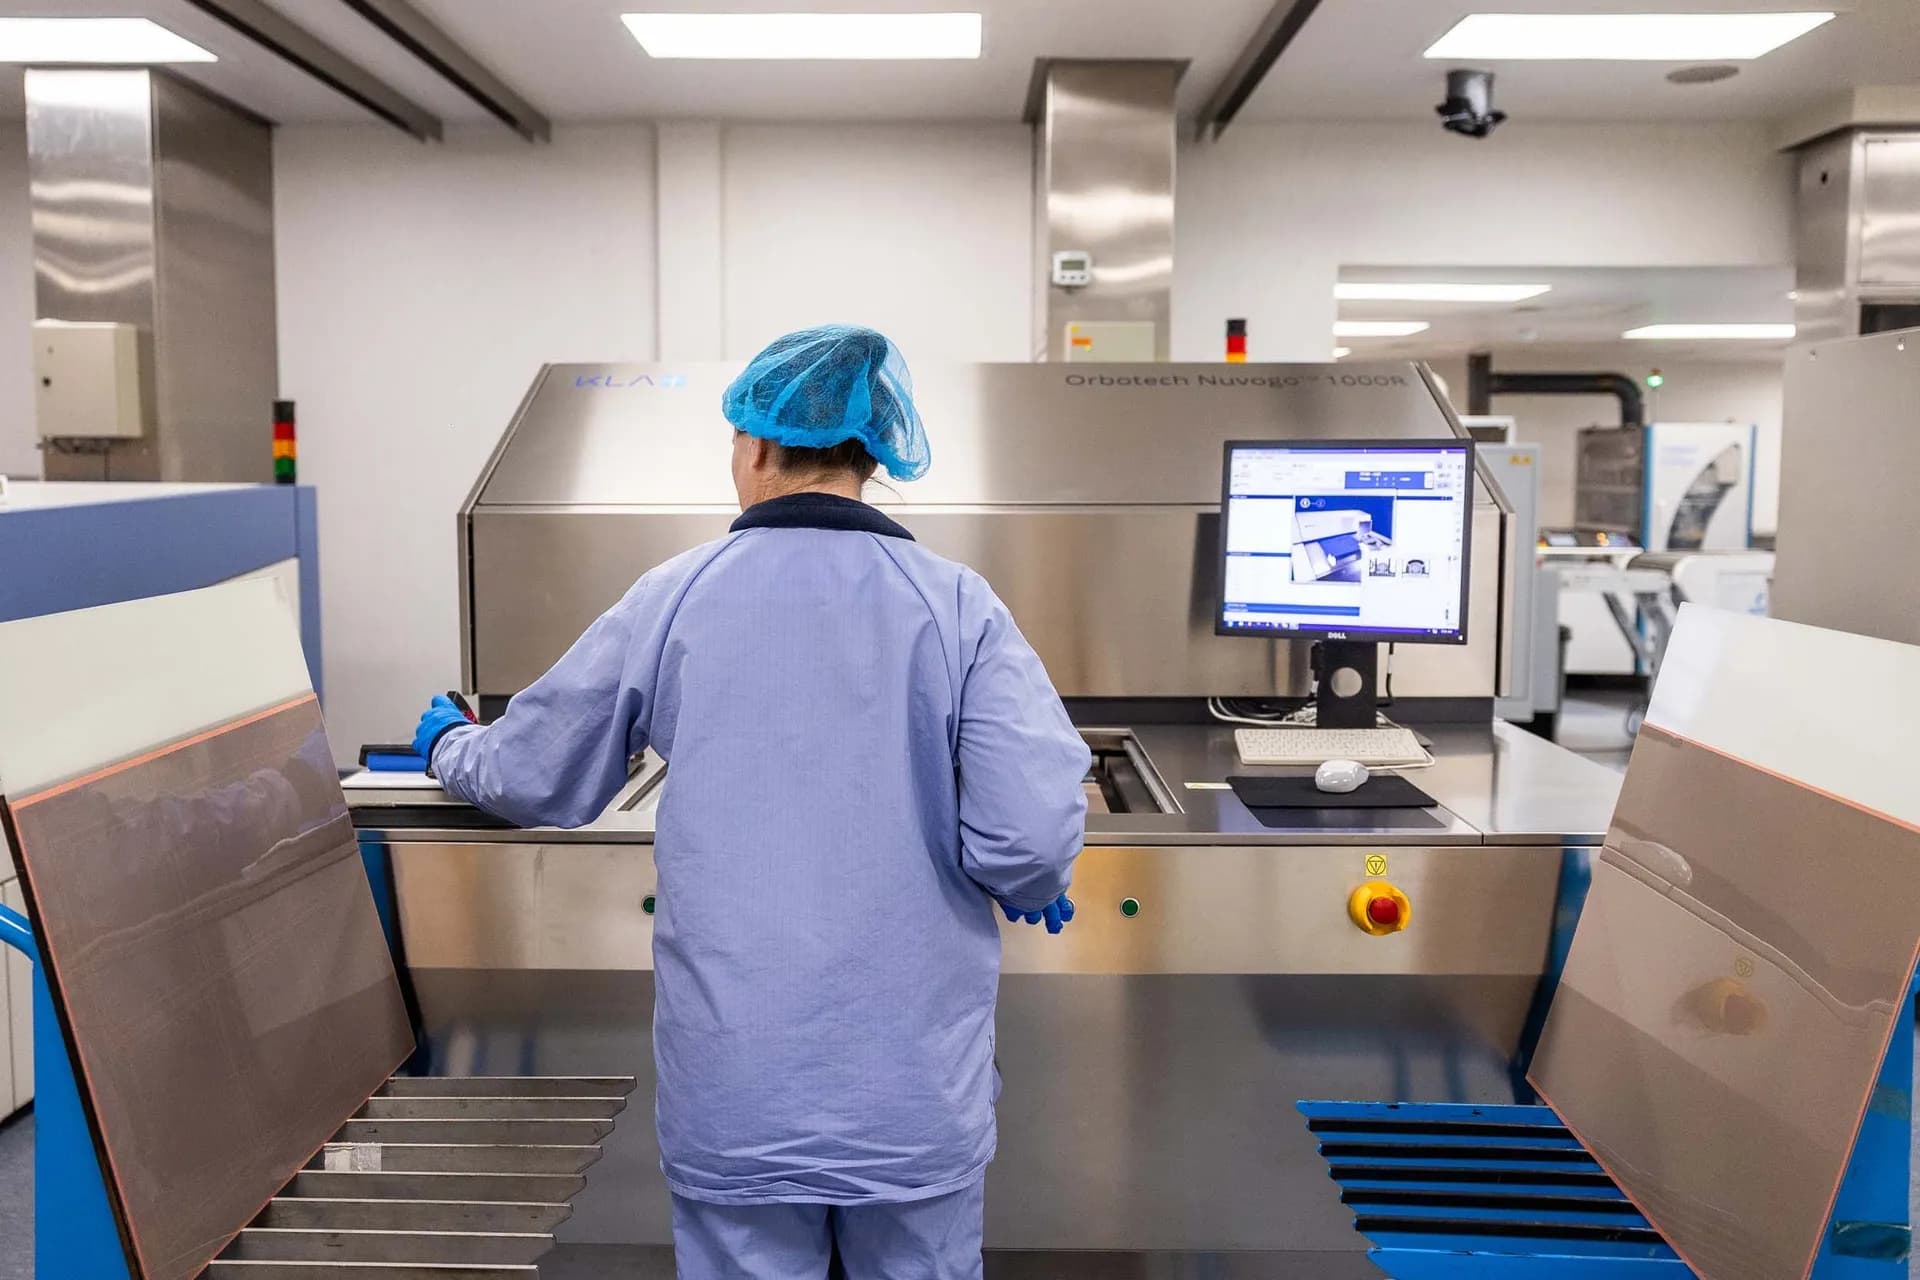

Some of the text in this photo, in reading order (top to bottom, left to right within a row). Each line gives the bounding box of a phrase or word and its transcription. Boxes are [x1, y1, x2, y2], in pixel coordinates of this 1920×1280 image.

[1065, 374, 1190, 387] Orbotech
[1326, 374, 1408, 387] 1000R
[1327, 631, 1347, 640] DELL
